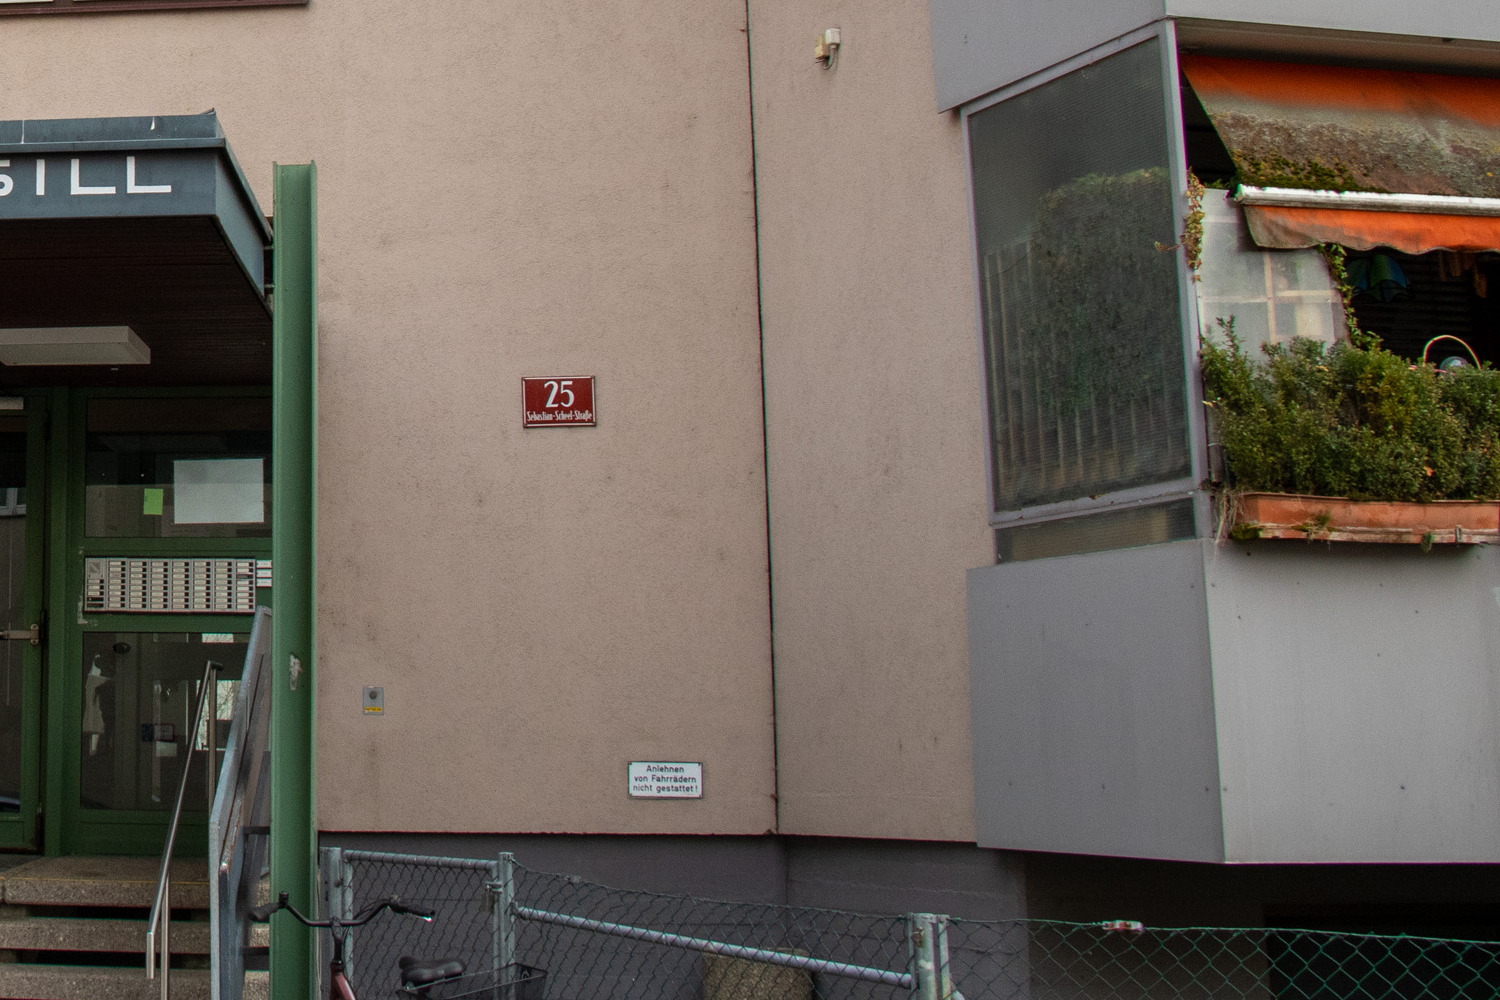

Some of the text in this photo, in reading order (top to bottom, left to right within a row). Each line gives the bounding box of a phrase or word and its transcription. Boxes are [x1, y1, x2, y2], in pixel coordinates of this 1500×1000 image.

[543, 380, 575, 408] 25
[646, 764, 685, 773] Anlehnen
[633, 774, 697, 784] von Fahrrädern
[632, 783, 653, 792] nicht
